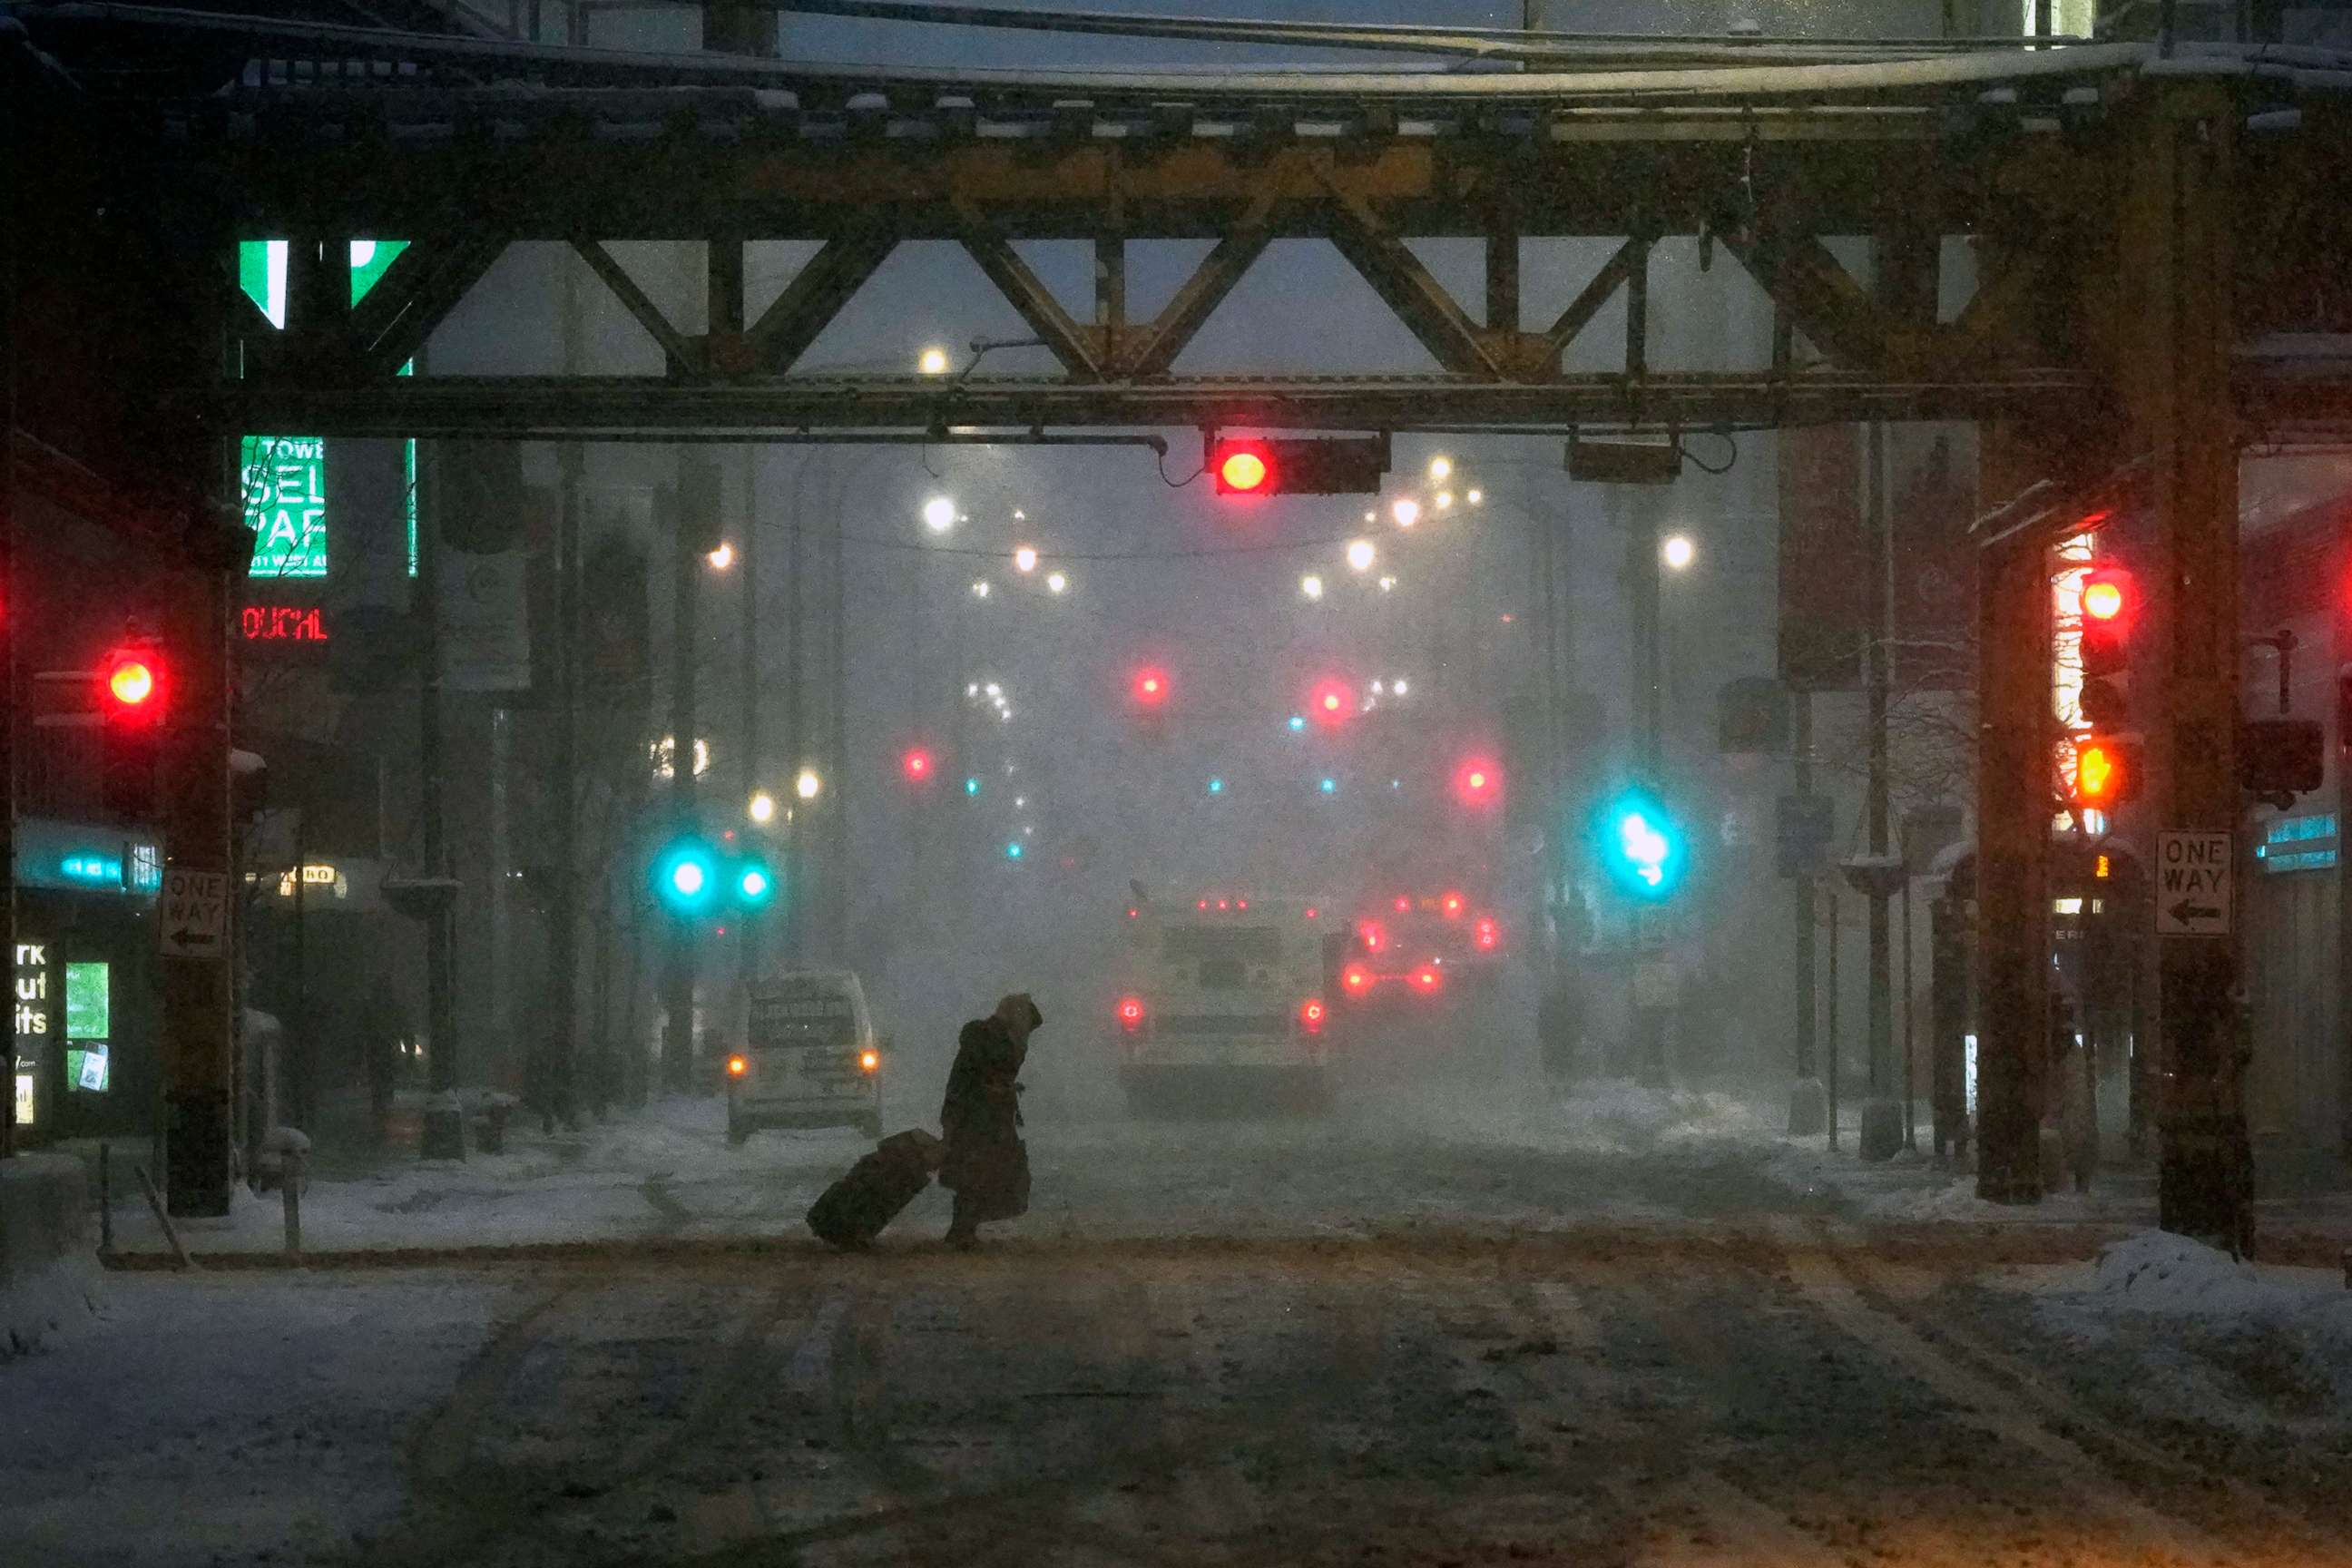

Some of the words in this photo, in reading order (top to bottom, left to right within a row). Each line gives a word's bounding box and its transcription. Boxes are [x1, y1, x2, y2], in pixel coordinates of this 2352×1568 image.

[2166, 839, 2224, 863] ONE
[171, 876, 221, 897] ONE
[2163, 869, 2225, 893] WAY
[169, 900, 220, 922] WAY
